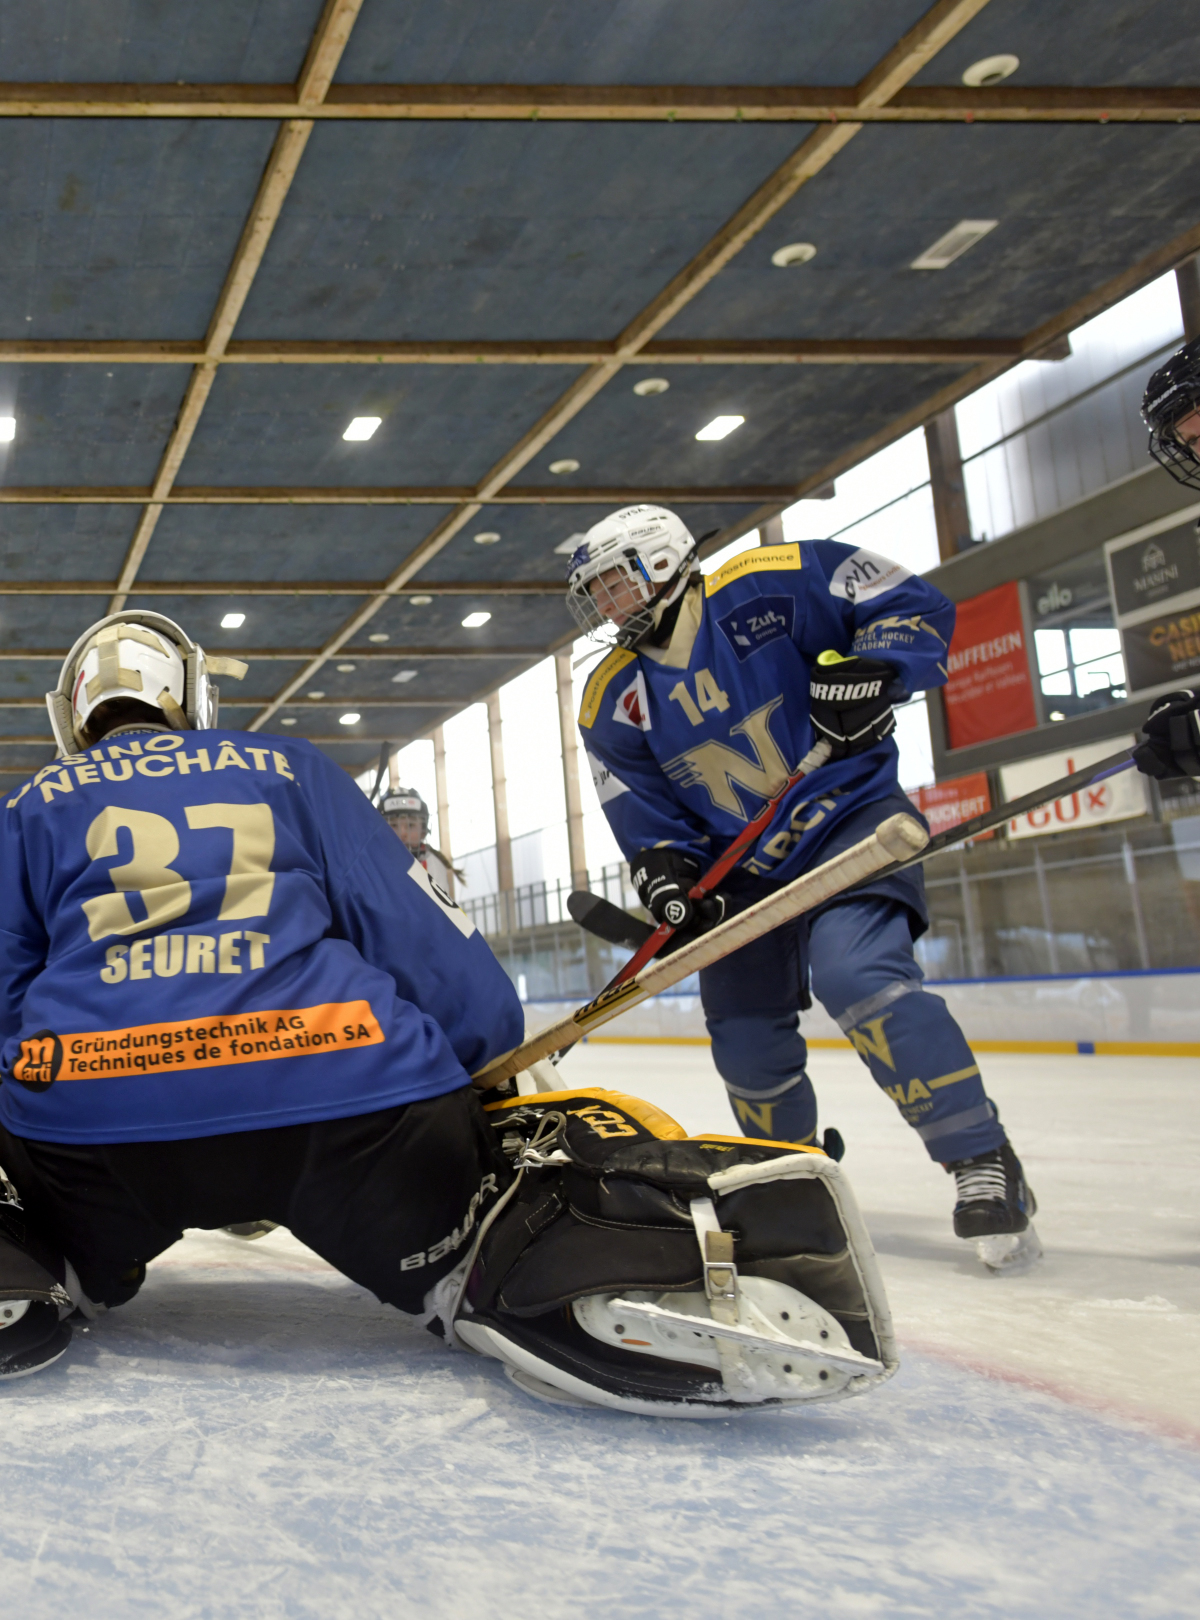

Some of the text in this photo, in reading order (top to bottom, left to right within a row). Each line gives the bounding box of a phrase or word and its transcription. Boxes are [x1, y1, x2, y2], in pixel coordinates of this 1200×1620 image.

[720, 554, 794, 579] PostFinance
[668, 668, 731, 727] 14
[39, 740, 301, 803] NEUCHÂTE
[81, 802, 276, 942] 37
[100, 930, 271, 985] SEURET
[68, 1023, 371, 1074] Techniques de fondation SA
[71, 1015, 306, 1056] Gründungstechnik AG
